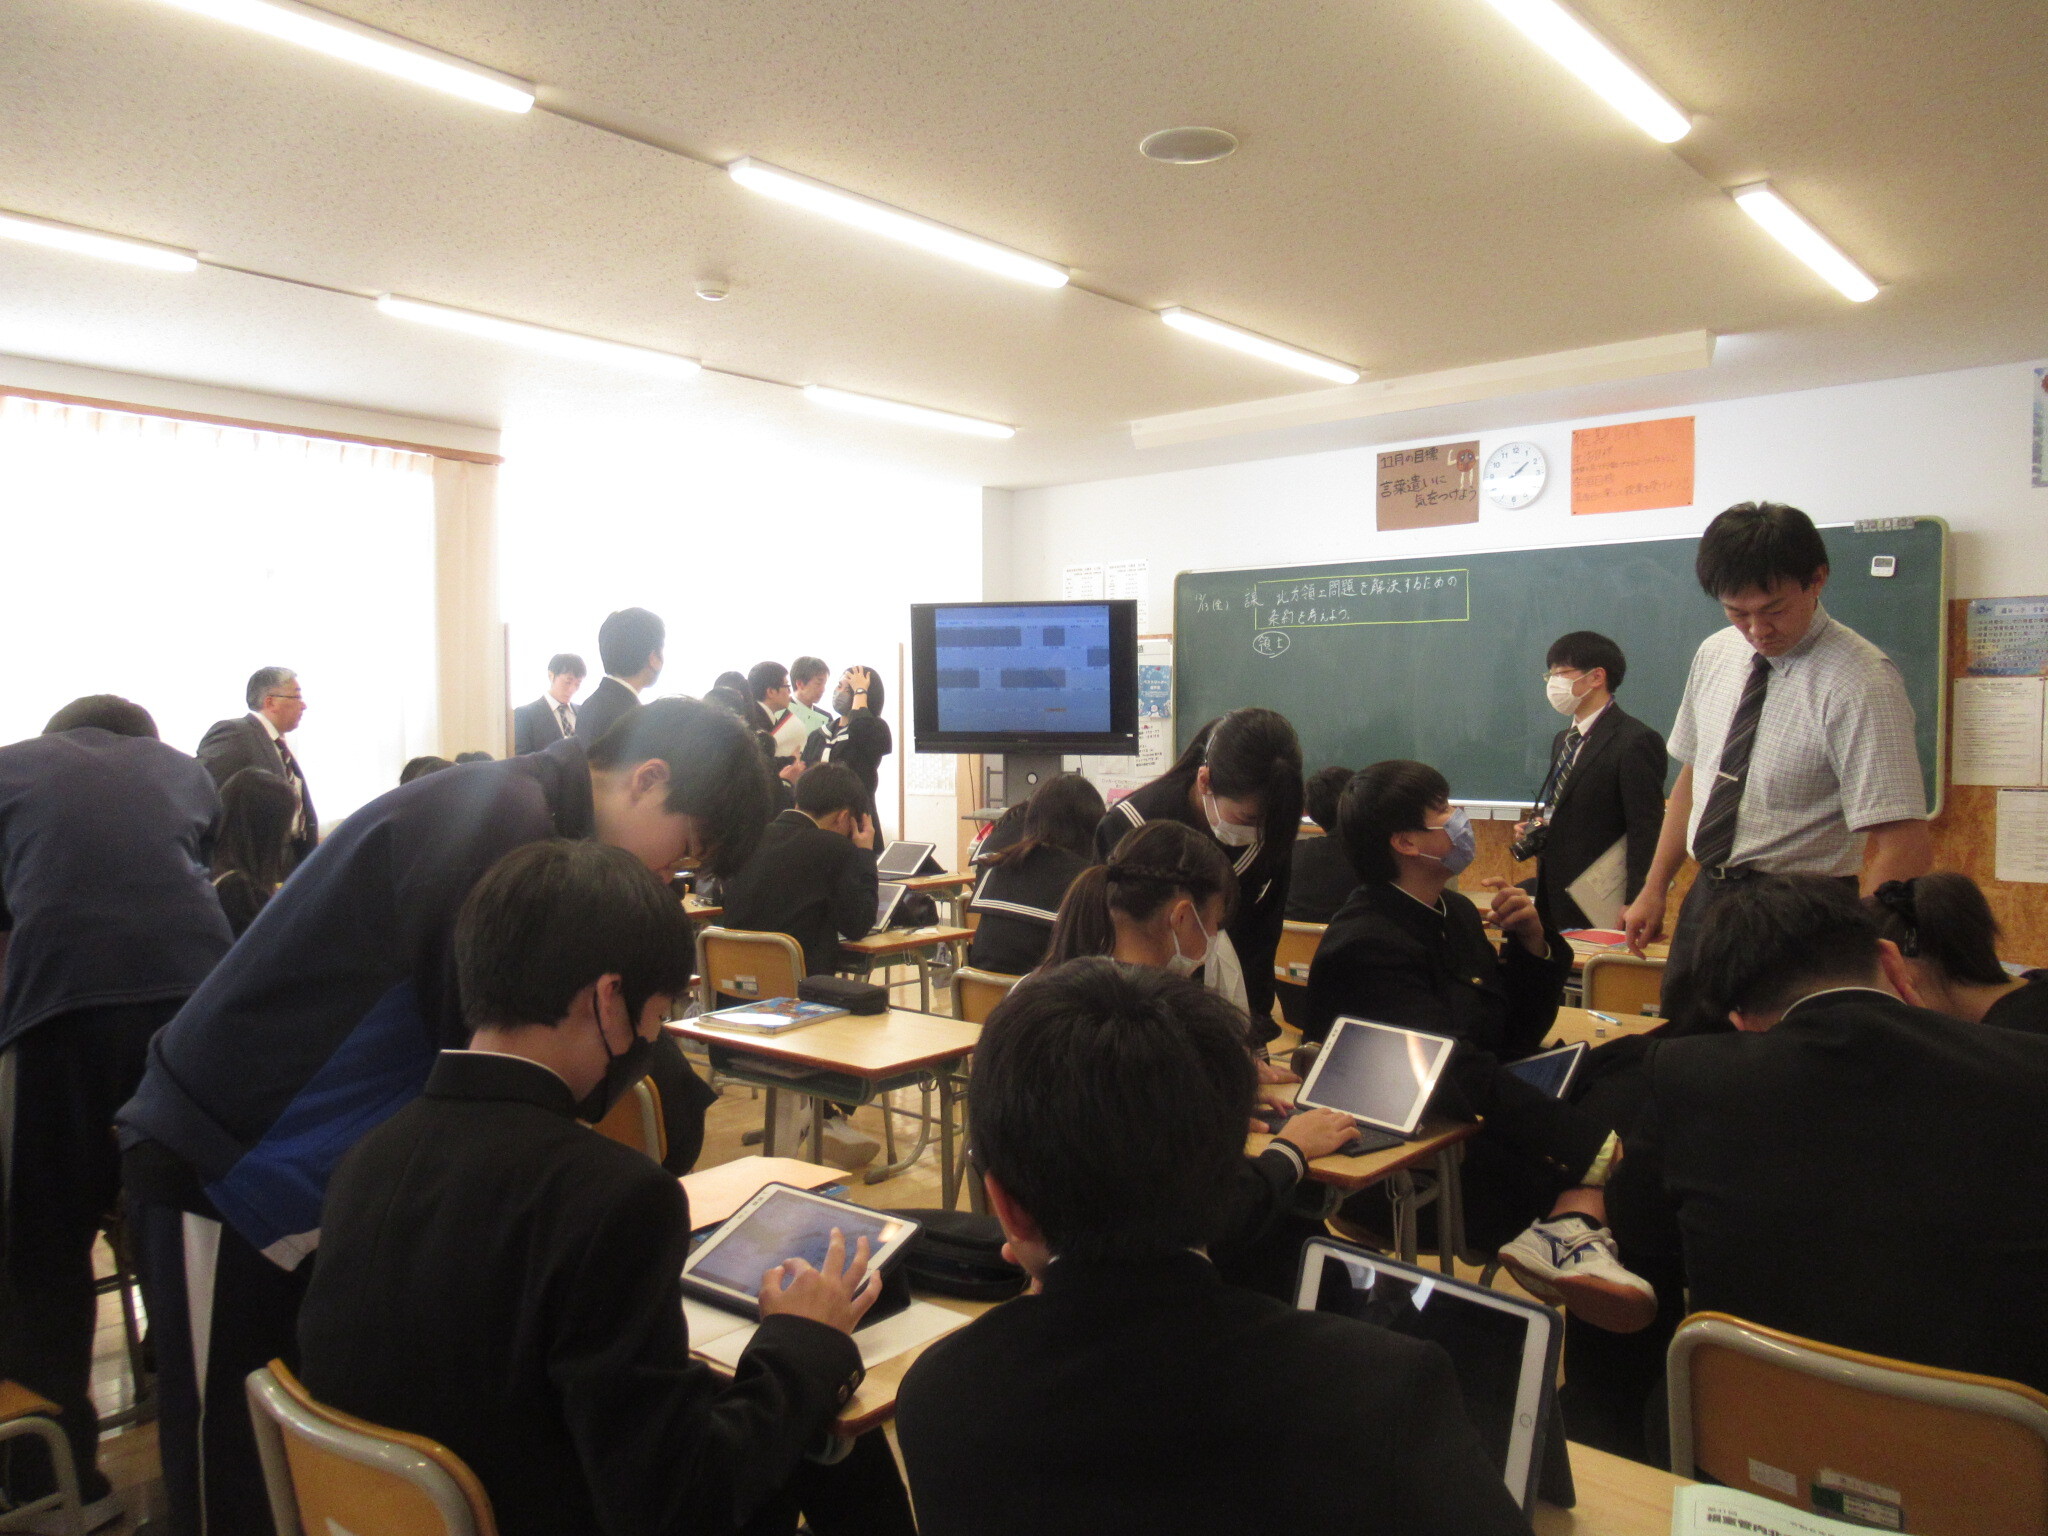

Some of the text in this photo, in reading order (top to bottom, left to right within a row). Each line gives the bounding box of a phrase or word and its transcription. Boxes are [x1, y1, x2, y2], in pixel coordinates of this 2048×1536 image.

[1381, 447, 1438, 469] 11月の目標
[1380, 475, 1447, 498] 言葉遣いに
[1415, 486, 1477, 508] 気をつけよう
[1276, 575, 1458, 606] 北方領土問題を解決するための
[1258, 635, 1283, 652] 領土
